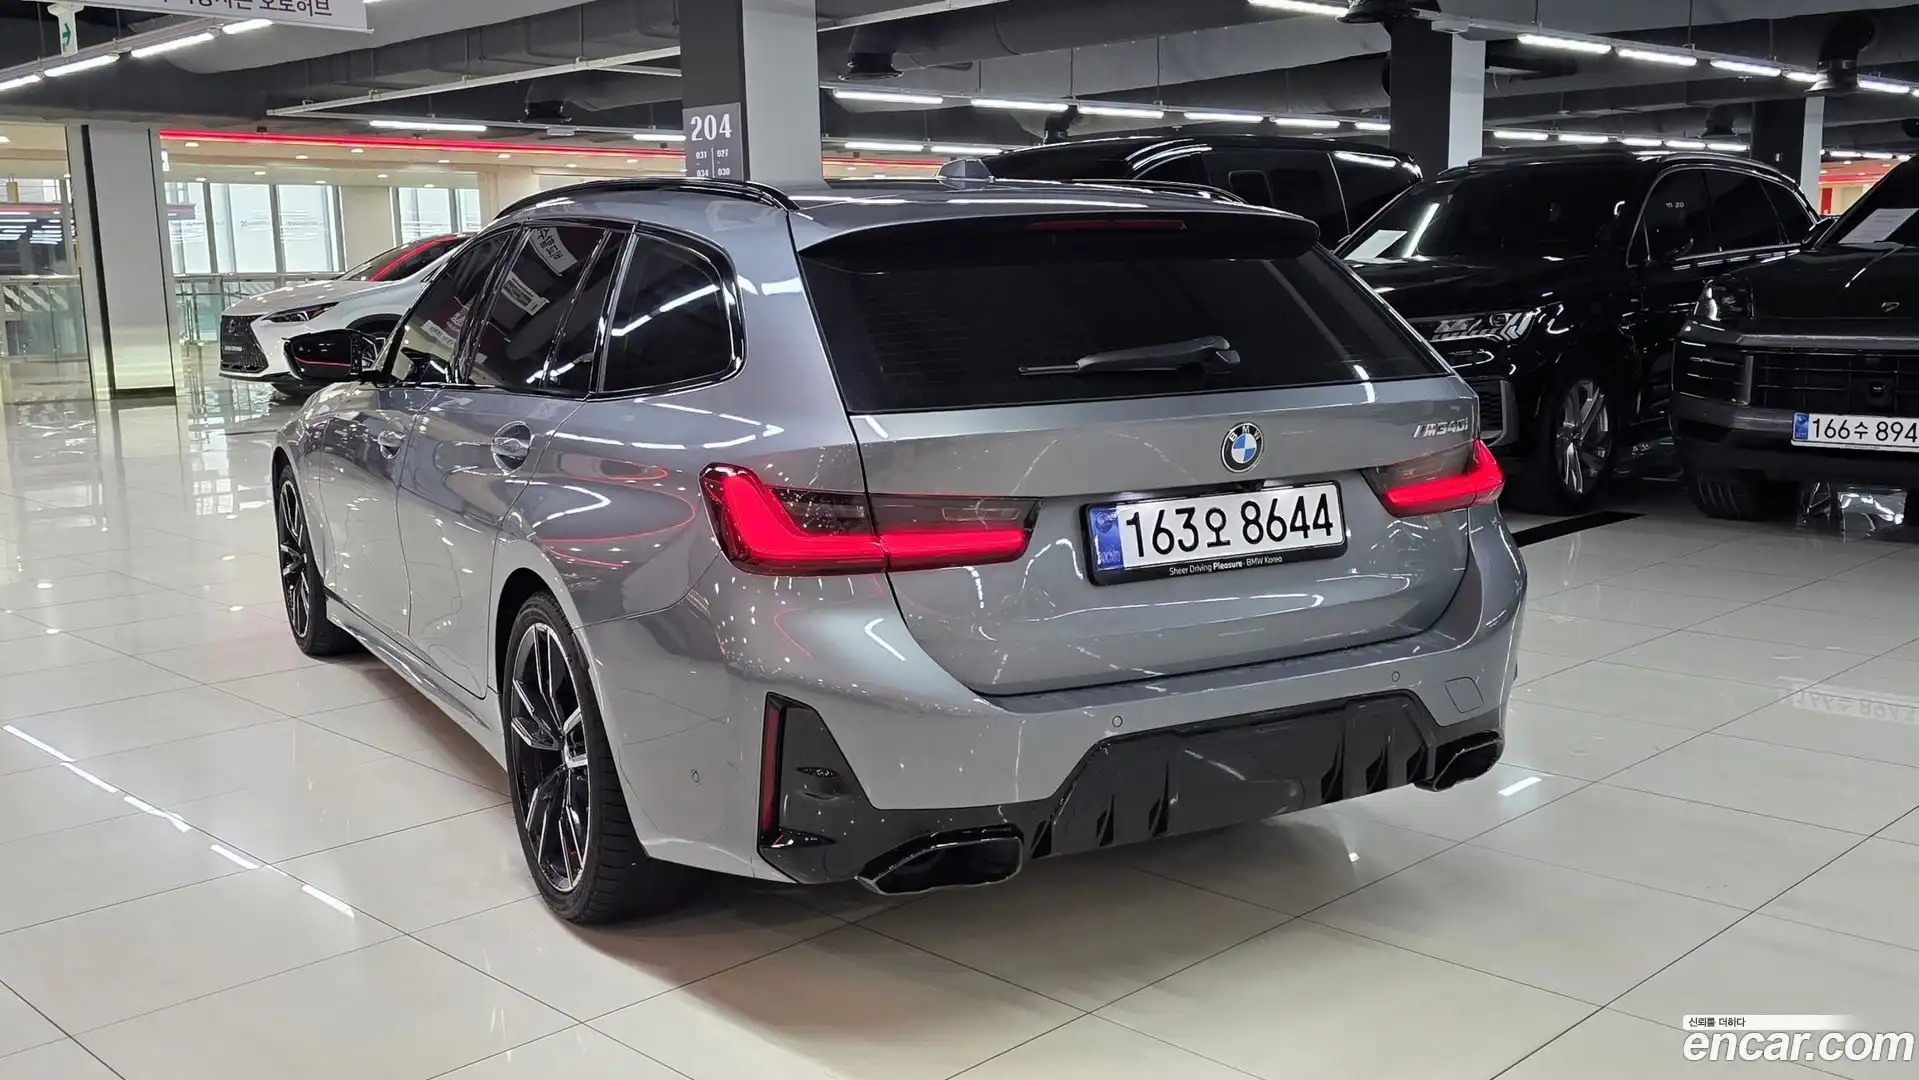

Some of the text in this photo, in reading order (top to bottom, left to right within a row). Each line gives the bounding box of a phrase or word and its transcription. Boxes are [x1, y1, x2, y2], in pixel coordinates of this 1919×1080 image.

[690, 114, 732, 141] 204
[695, 151, 707, 159] 031
[716, 149, 728, 157] 027
[1229, 425, 1261, 442] BMW
[1413, 417, 1468, 438] M340i
[1812, 418, 1868, 440] 166수
[1126, 493, 1333, 558] 163오 8644
[1169, 565, 1188, 576] Sheer
[1189, 563, 1212, 574] Driving
[1246, 556, 1263, 566] BMW
[1264, 554, 1283, 564] Korea
